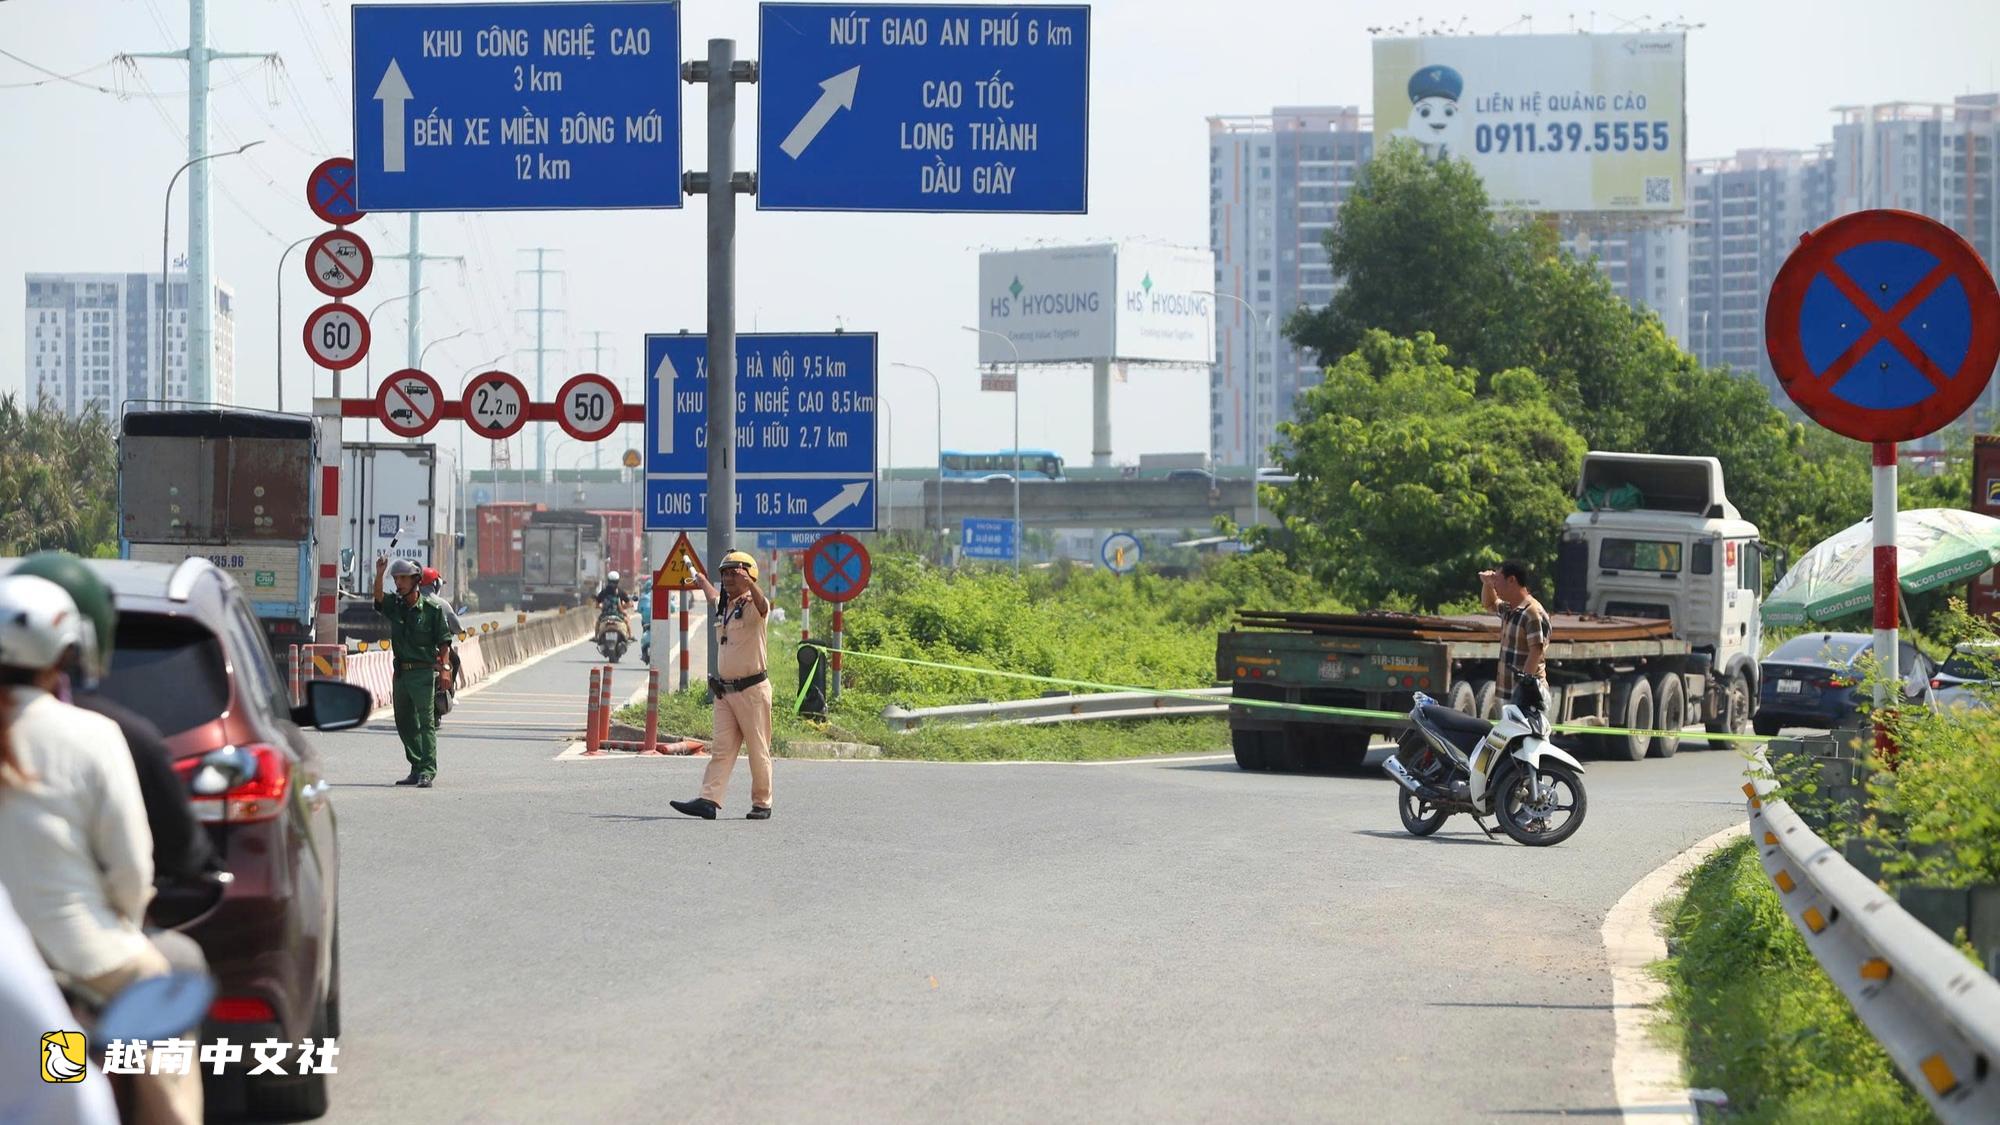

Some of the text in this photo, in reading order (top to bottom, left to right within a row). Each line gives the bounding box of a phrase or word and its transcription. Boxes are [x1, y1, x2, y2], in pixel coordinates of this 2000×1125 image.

[423, 23, 650, 59] KHU CÔNG NGHỆ CAO
[830, 10, 1072, 46] NÚT GIAO AN PHÚ 6 km
[513, 64, 562, 92] 3 km
[922, 69, 1014, 109] CAO TỐC
[1476, 92, 1514, 113] LIÊN
[1520, 91, 1542, 116] HỆ
[414, 105, 663, 146] BẾN XE MIỀN ĐÔNG MỚI
[901, 117, 1037, 151] LONG THÀNH
[1475, 121, 1669, 153] 0911.39.5555
[515, 153, 571, 180] 12 km
[921, 154, 1017, 194] DẦU GIÂY
[991, 292, 1099, 318] HS HYOSUNG
[1127, 290, 1207, 317] HS HYOSUNG
[323, 322, 350, 350] 60
[696, 357, 707, 378] X
[747, 350, 764, 378] HÀ
[773, 350, 794, 382] NỘI
[803, 357, 822, 379] 9,5
[826, 356, 846, 378] km
[575, 393, 604, 421] 50
[677, 392, 703, 413] KHU
[755, 386, 789, 416] NGHỆ
[798, 391, 824, 412] CAO
[832, 391, 850, 414] 8,5
[854, 391, 873, 412] km
[763, 421, 789, 448] HỮU
[800, 426, 821, 449] 2,7
[828, 426, 848, 448] km
[657, 493, 691, 514] LONG
[755, 493, 781, 516] 18,5
[788, 493, 807, 514] km
